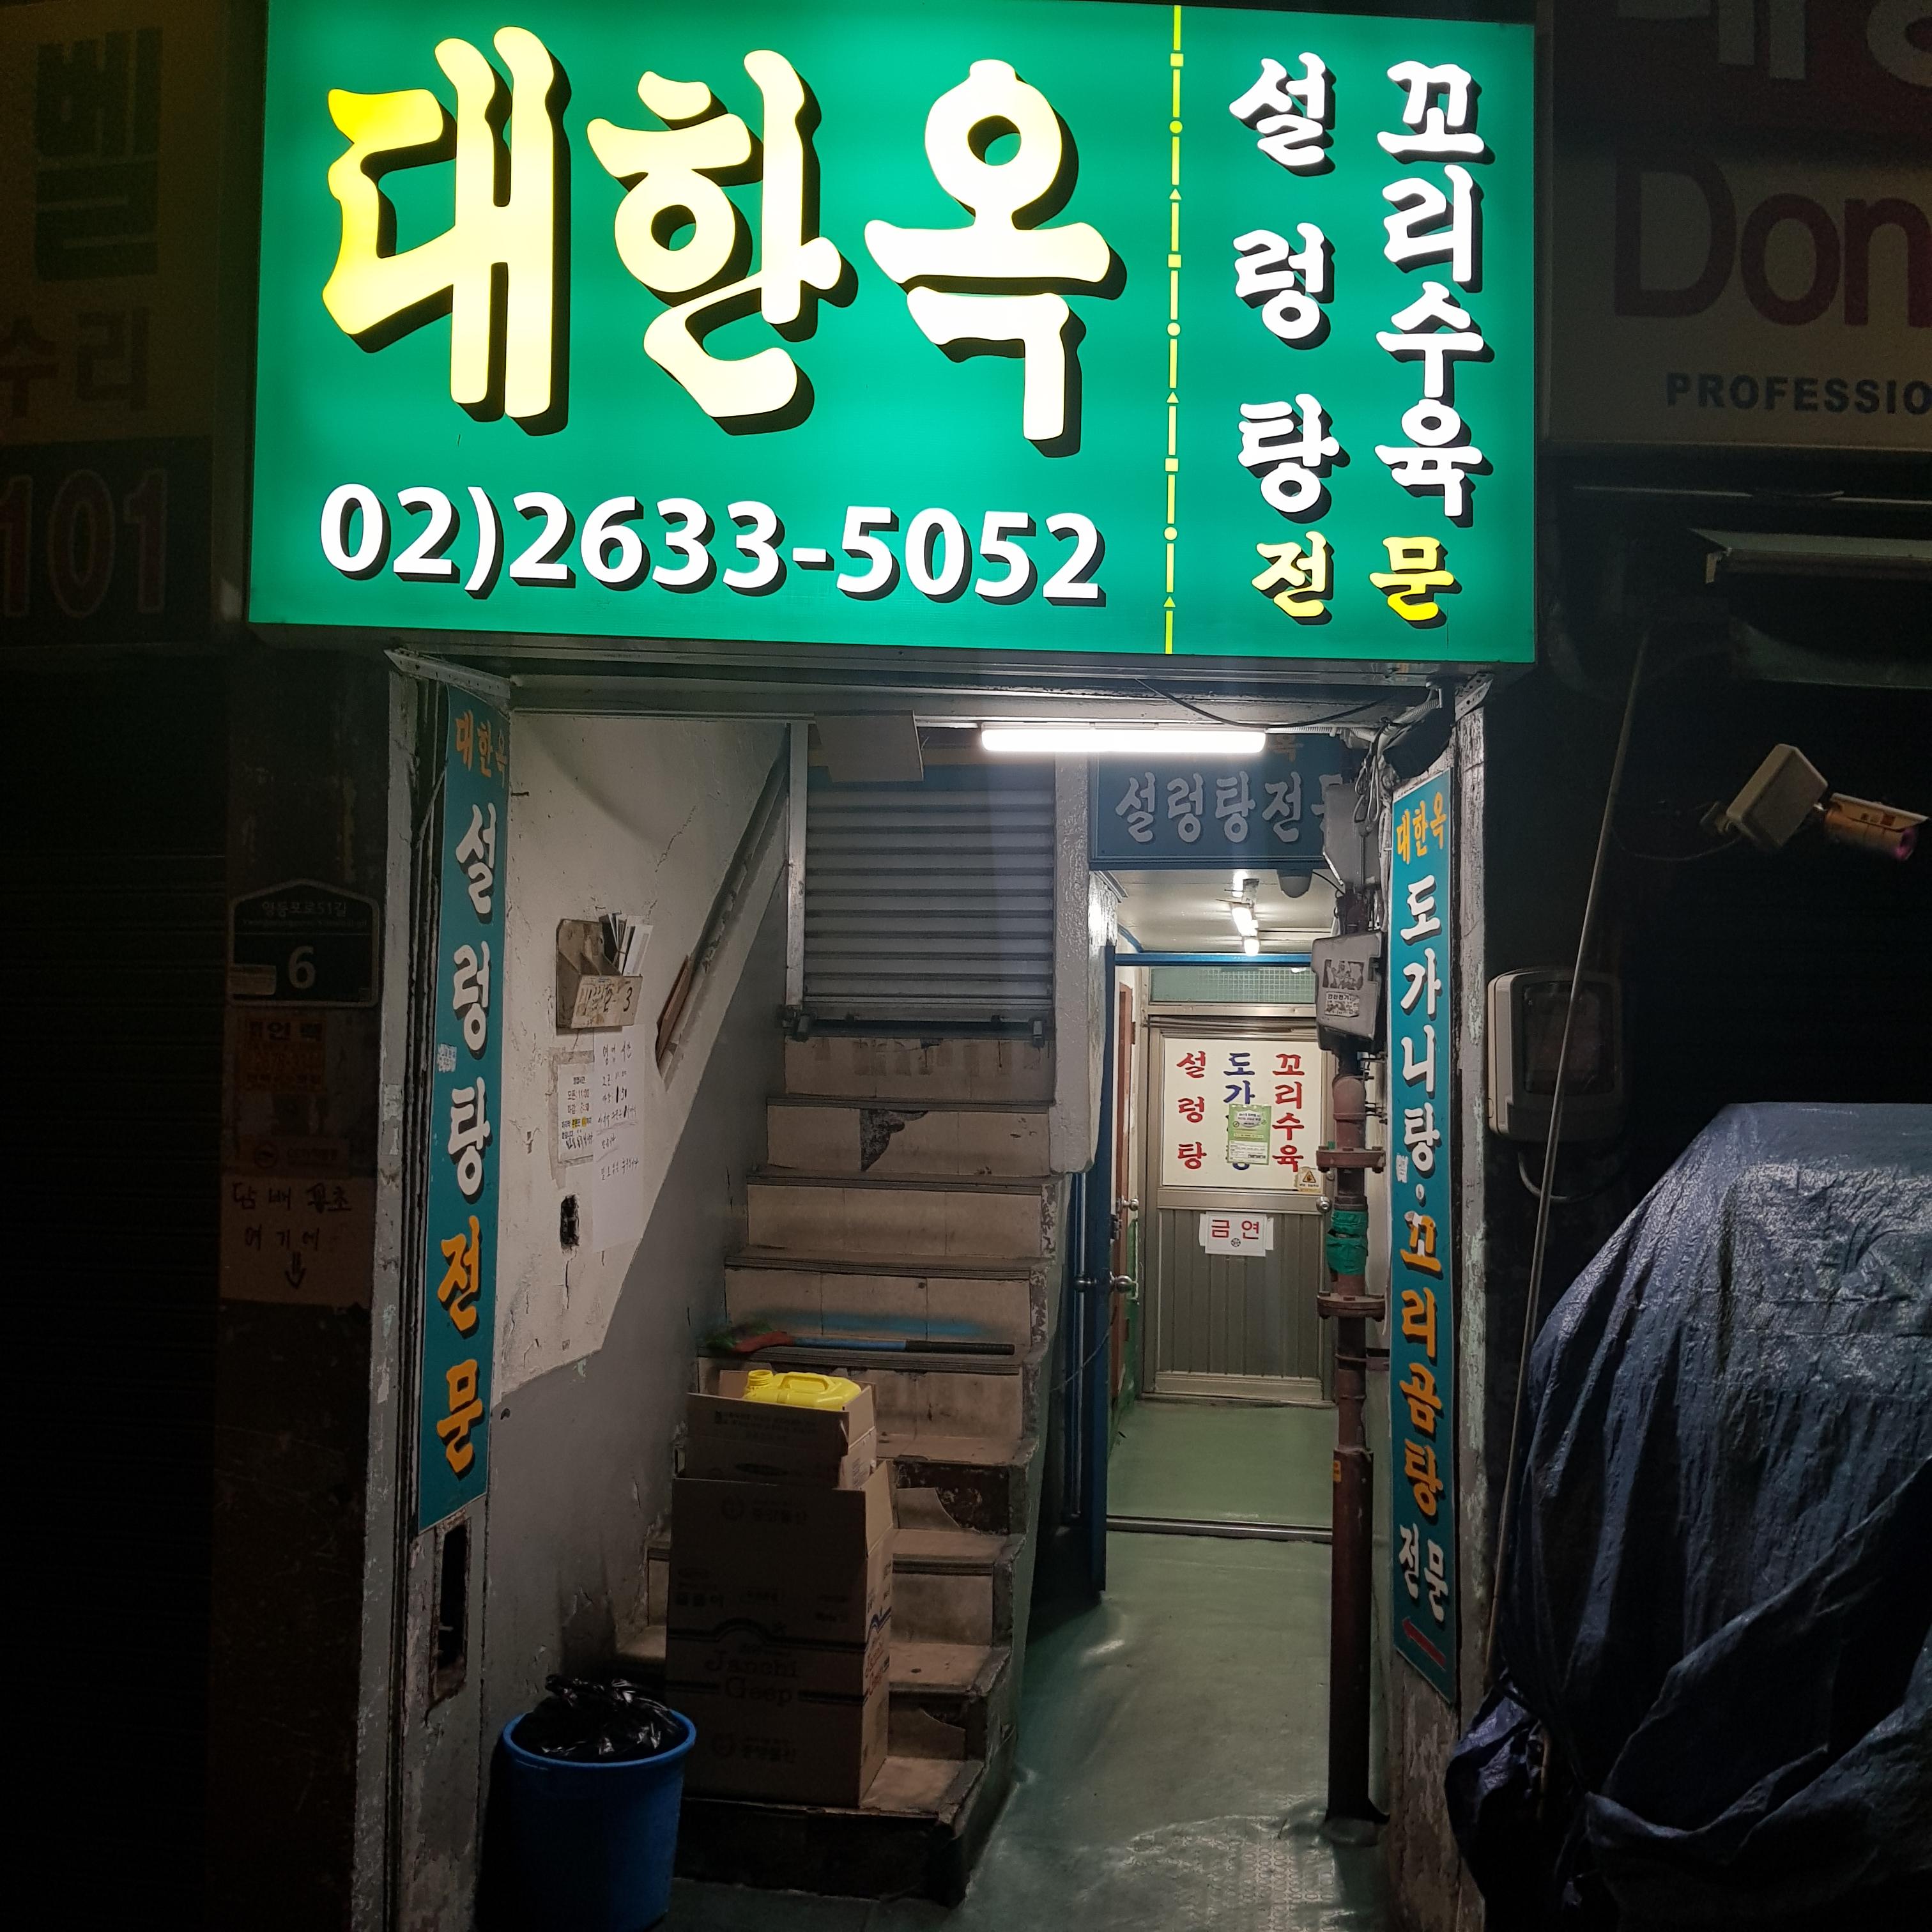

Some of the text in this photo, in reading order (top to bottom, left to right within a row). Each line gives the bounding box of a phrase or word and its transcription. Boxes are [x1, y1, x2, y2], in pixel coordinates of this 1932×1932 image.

[323, 26, 1110, 441] 대한옥
[1229, 52, 1340, 513] 설렁탕
[1377, 59, 1484, 516] 꼬리수육
[1667, 372, 1932, 415] PROFESSIO
[319, 484, 1101, 601] 02)2633-5052
[1252, 531, 1454, 621] 전문
[456, 709, 507, 788] 대한옥
[1397, 792, 1446, 864] 대한옥
[289, 945, 317, 989] 6
[436, 802, 496, 1473] 설렁탕 전문
[1176, 1051, 1207, 1169] 설렁탕
[1272, 1054, 1305, 1172] 꼬리수육
[1211, 1220, 1259, 1239] 금연
[1399, 874, 1448, 1622] 도가니탕 꼬리곰탕 전문
